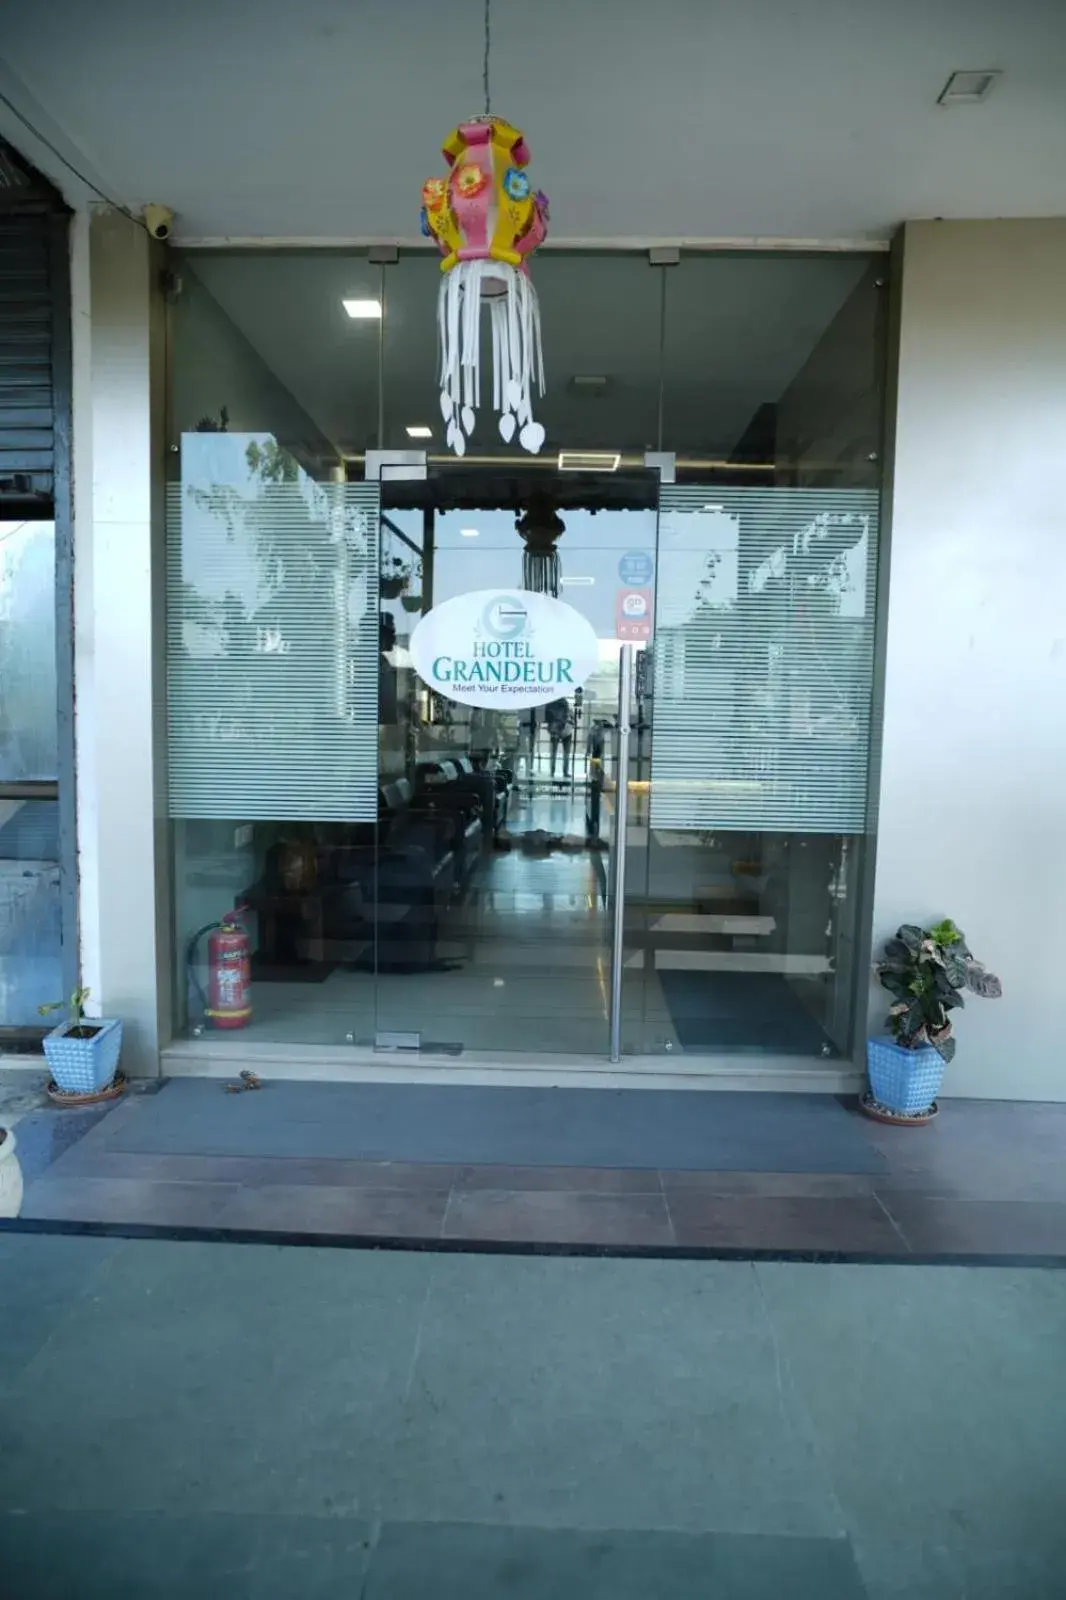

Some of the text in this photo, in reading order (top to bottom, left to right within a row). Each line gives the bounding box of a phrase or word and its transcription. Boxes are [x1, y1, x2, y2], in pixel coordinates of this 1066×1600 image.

[473, 641, 535, 658] HOTEL
[432, 656, 574, 683] GRANDEUR
[453, 684, 555, 694] Meet Your Expectation
